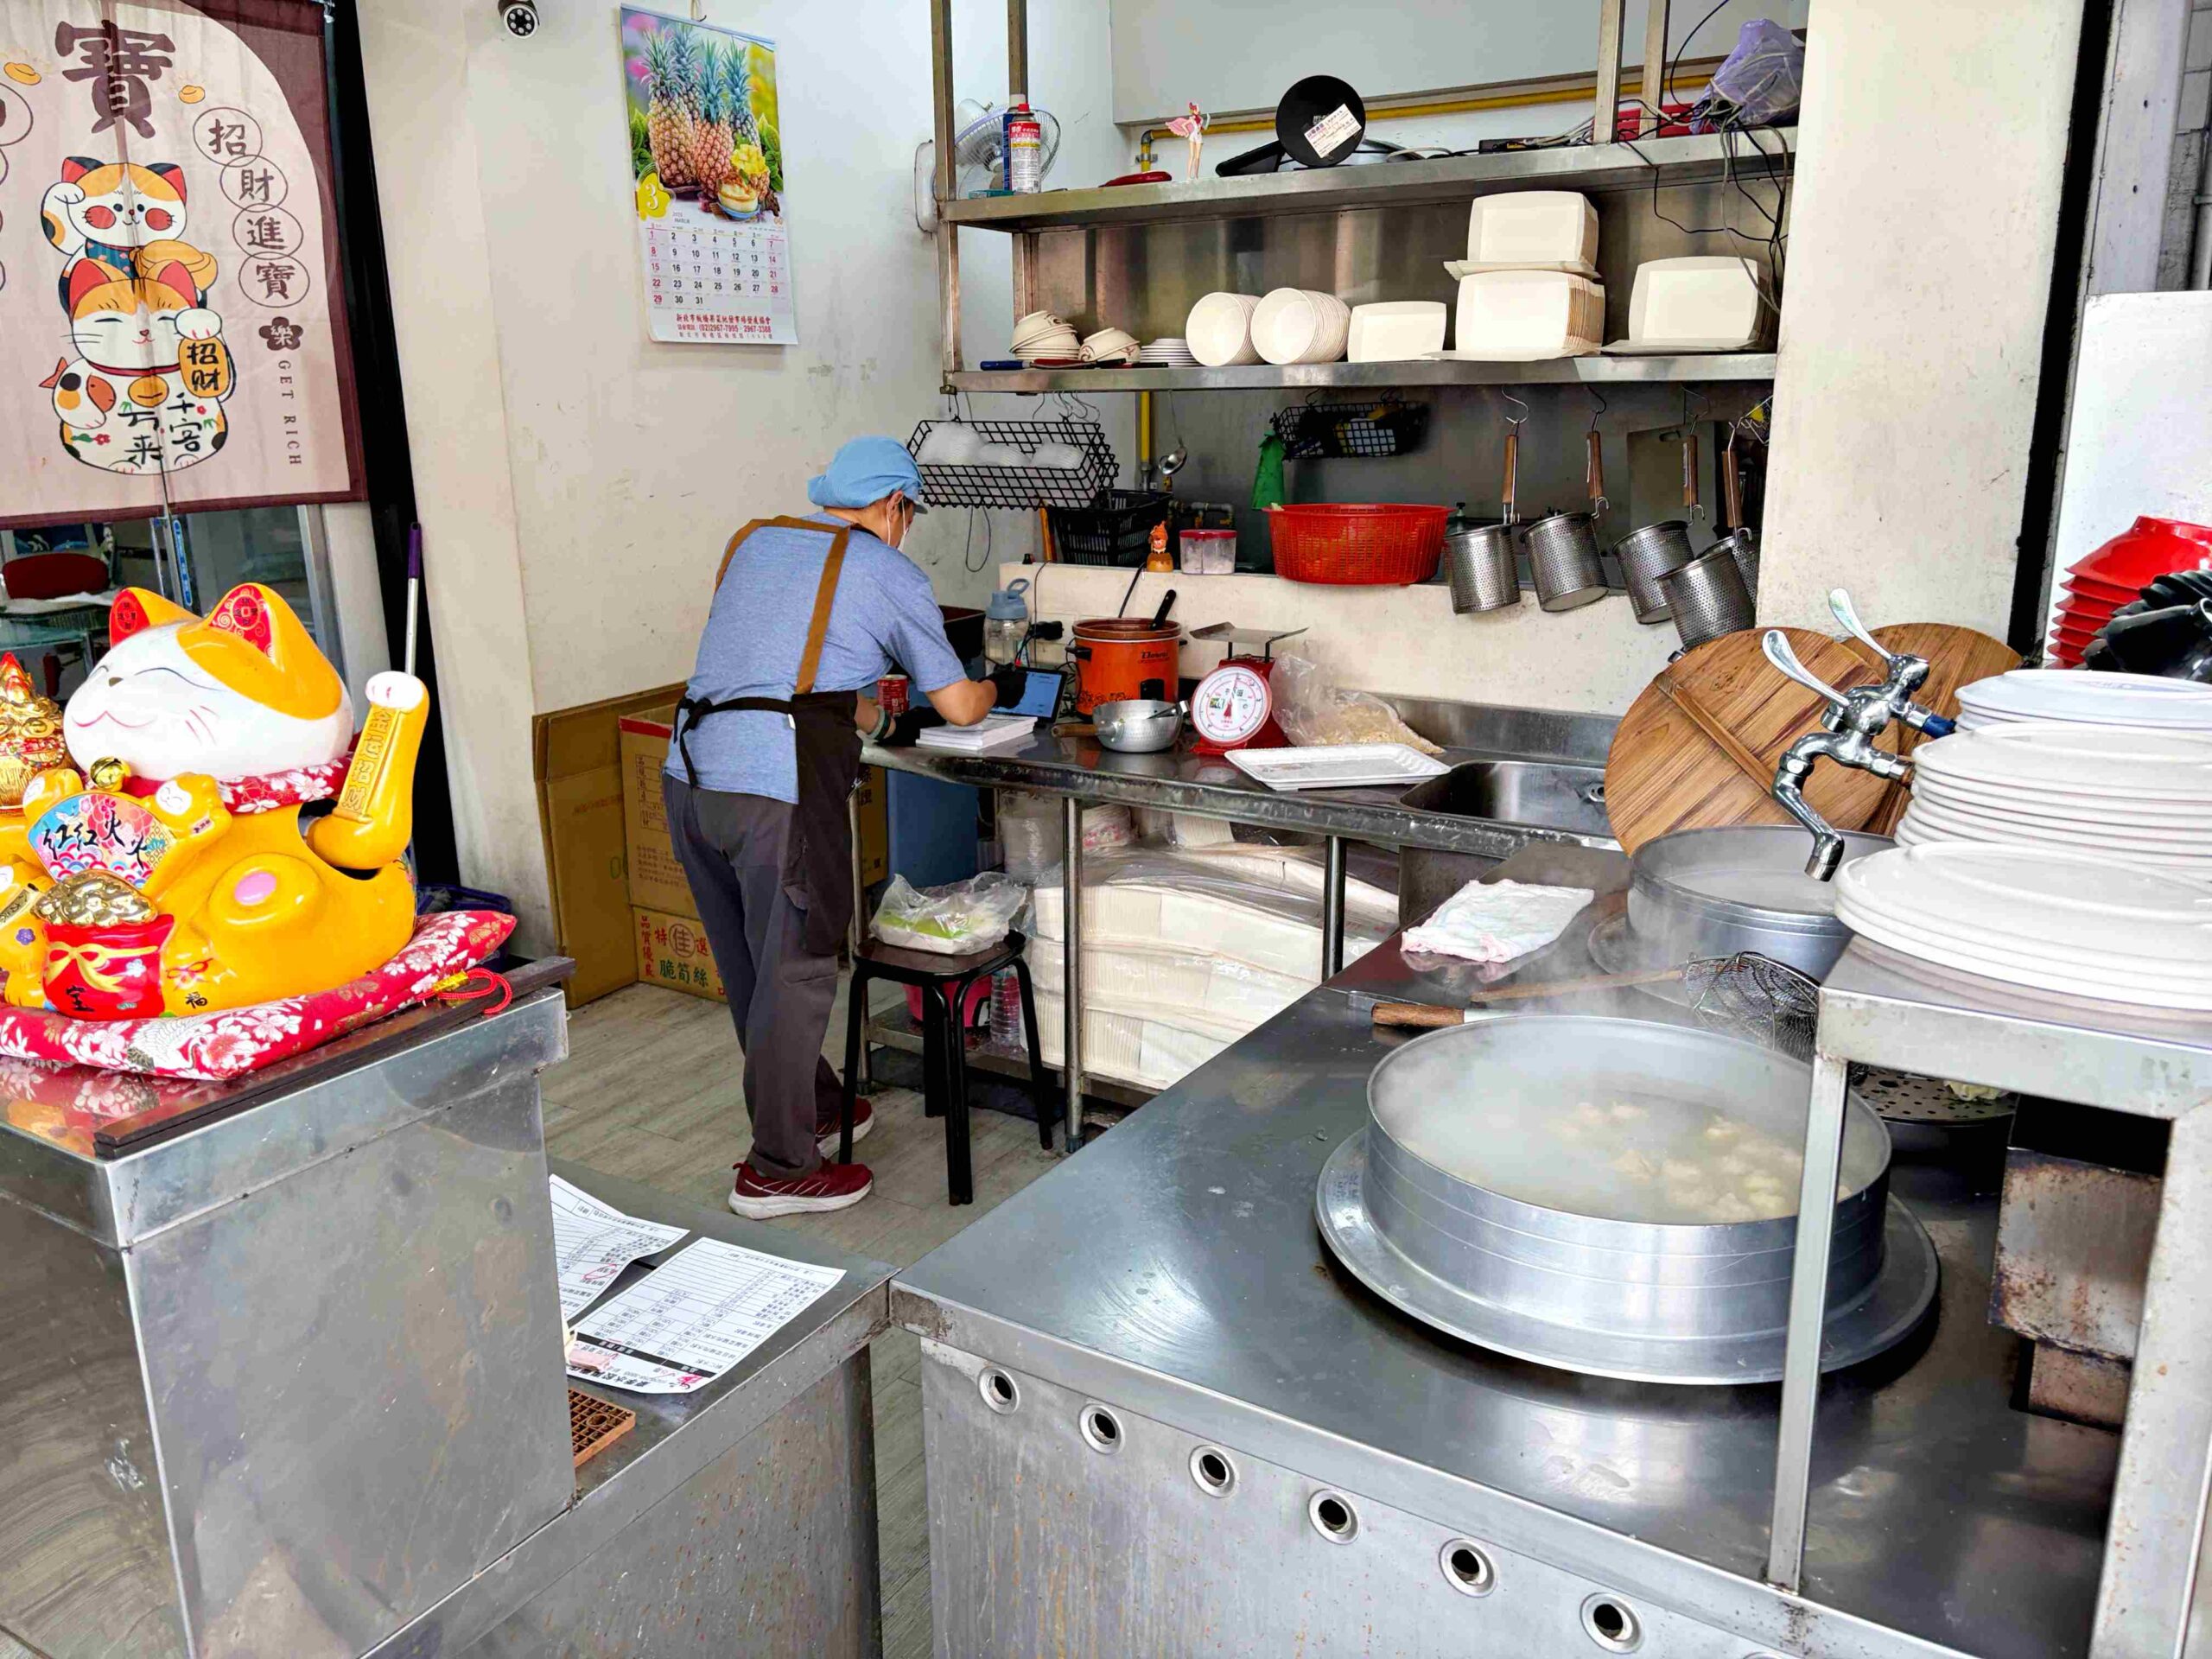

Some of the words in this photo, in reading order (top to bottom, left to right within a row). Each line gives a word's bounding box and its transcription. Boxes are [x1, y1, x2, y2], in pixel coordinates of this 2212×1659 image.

[55, 19, 175, 139] 寶
[208, 118, 296, 300] 招財進寶
[645, 184, 658, 210] 3
[652, 263, 659, 271] 15
[278, 359, 295, 399] GET
[283, 415, 302, 465] RICH
[659, 959, 709, 988] 脆筍絲
[185, 991, 208, 1009] 福
